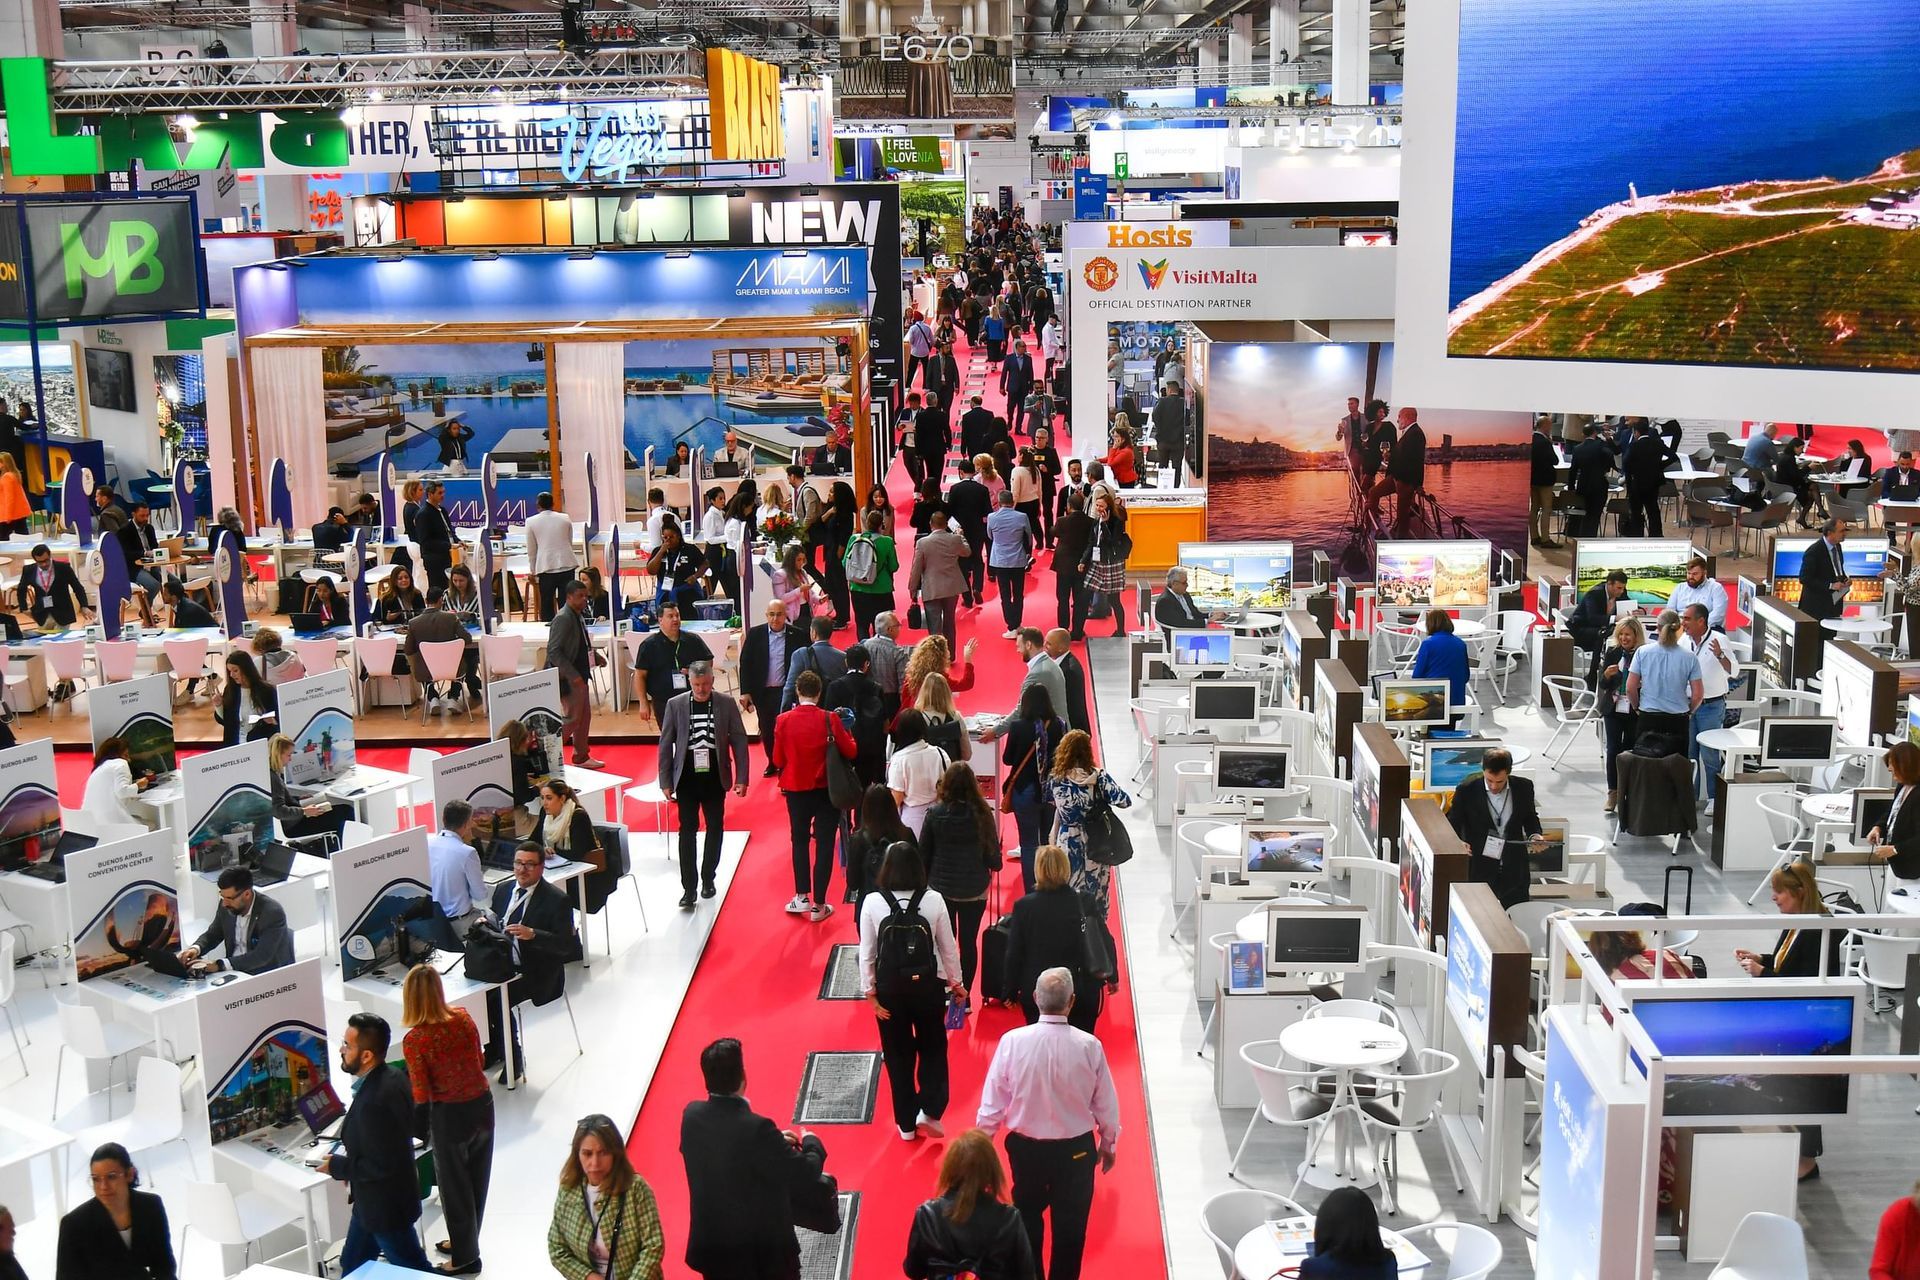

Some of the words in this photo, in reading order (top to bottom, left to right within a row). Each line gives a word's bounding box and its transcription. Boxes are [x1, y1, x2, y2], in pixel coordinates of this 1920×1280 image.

[880, 35, 973, 62] E670
[708, 47, 786, 160] BRASIL
[541, 109, 687, 184] Vegas
[886, 138, 892, 150] I
[893, 138, 916, 151] FEEL
[887, 151, 934, 164] SLOVENIA
[751, 200, 882, 245] NEW
[1107, 224, 1193, 248] Hosts
[60, 220, 165, 299] MB
[736, 256, 850, 286] MIAMI
[0, 262, 18, 281] ON
[1172, 269, 1257, 285] VisitMalta
[735, 288, 770, 296] GREATER
[801, 287, 823, 295] MIAMI
[1088, 300, 1134, 309] OFFICIAL
[1136, 299, 1205, 309] DESTINATION
[1207, 299, 1252, 308] PARTNER
[22, 755, 38, 764] AIRES
[201, 764, 220, 774] GRAND
[220, 759, 240, 769] HOTELS
[240, 756, 251, 764] LUX
[440, 764, 467, 776] VIVATERRA
[466, 760, 478, 769] DMC
[477, 753, 504, 766] ARGENTINA
[87, 862, 128, 879] CONVENTION
[128, 855, 154, 868] CENTER
[97, 856, 124, 869] BUENOS
[124, 851, 143, 861] AIRES
[353, 853, 386, 869] BARILOCHE
[386, 846, 410, 859] BUREAU
[224, 999, 244, 1011] VISIT
[244, 989, 275, 1005] BUENOS
[275, 982, 298, 996] AIRES
